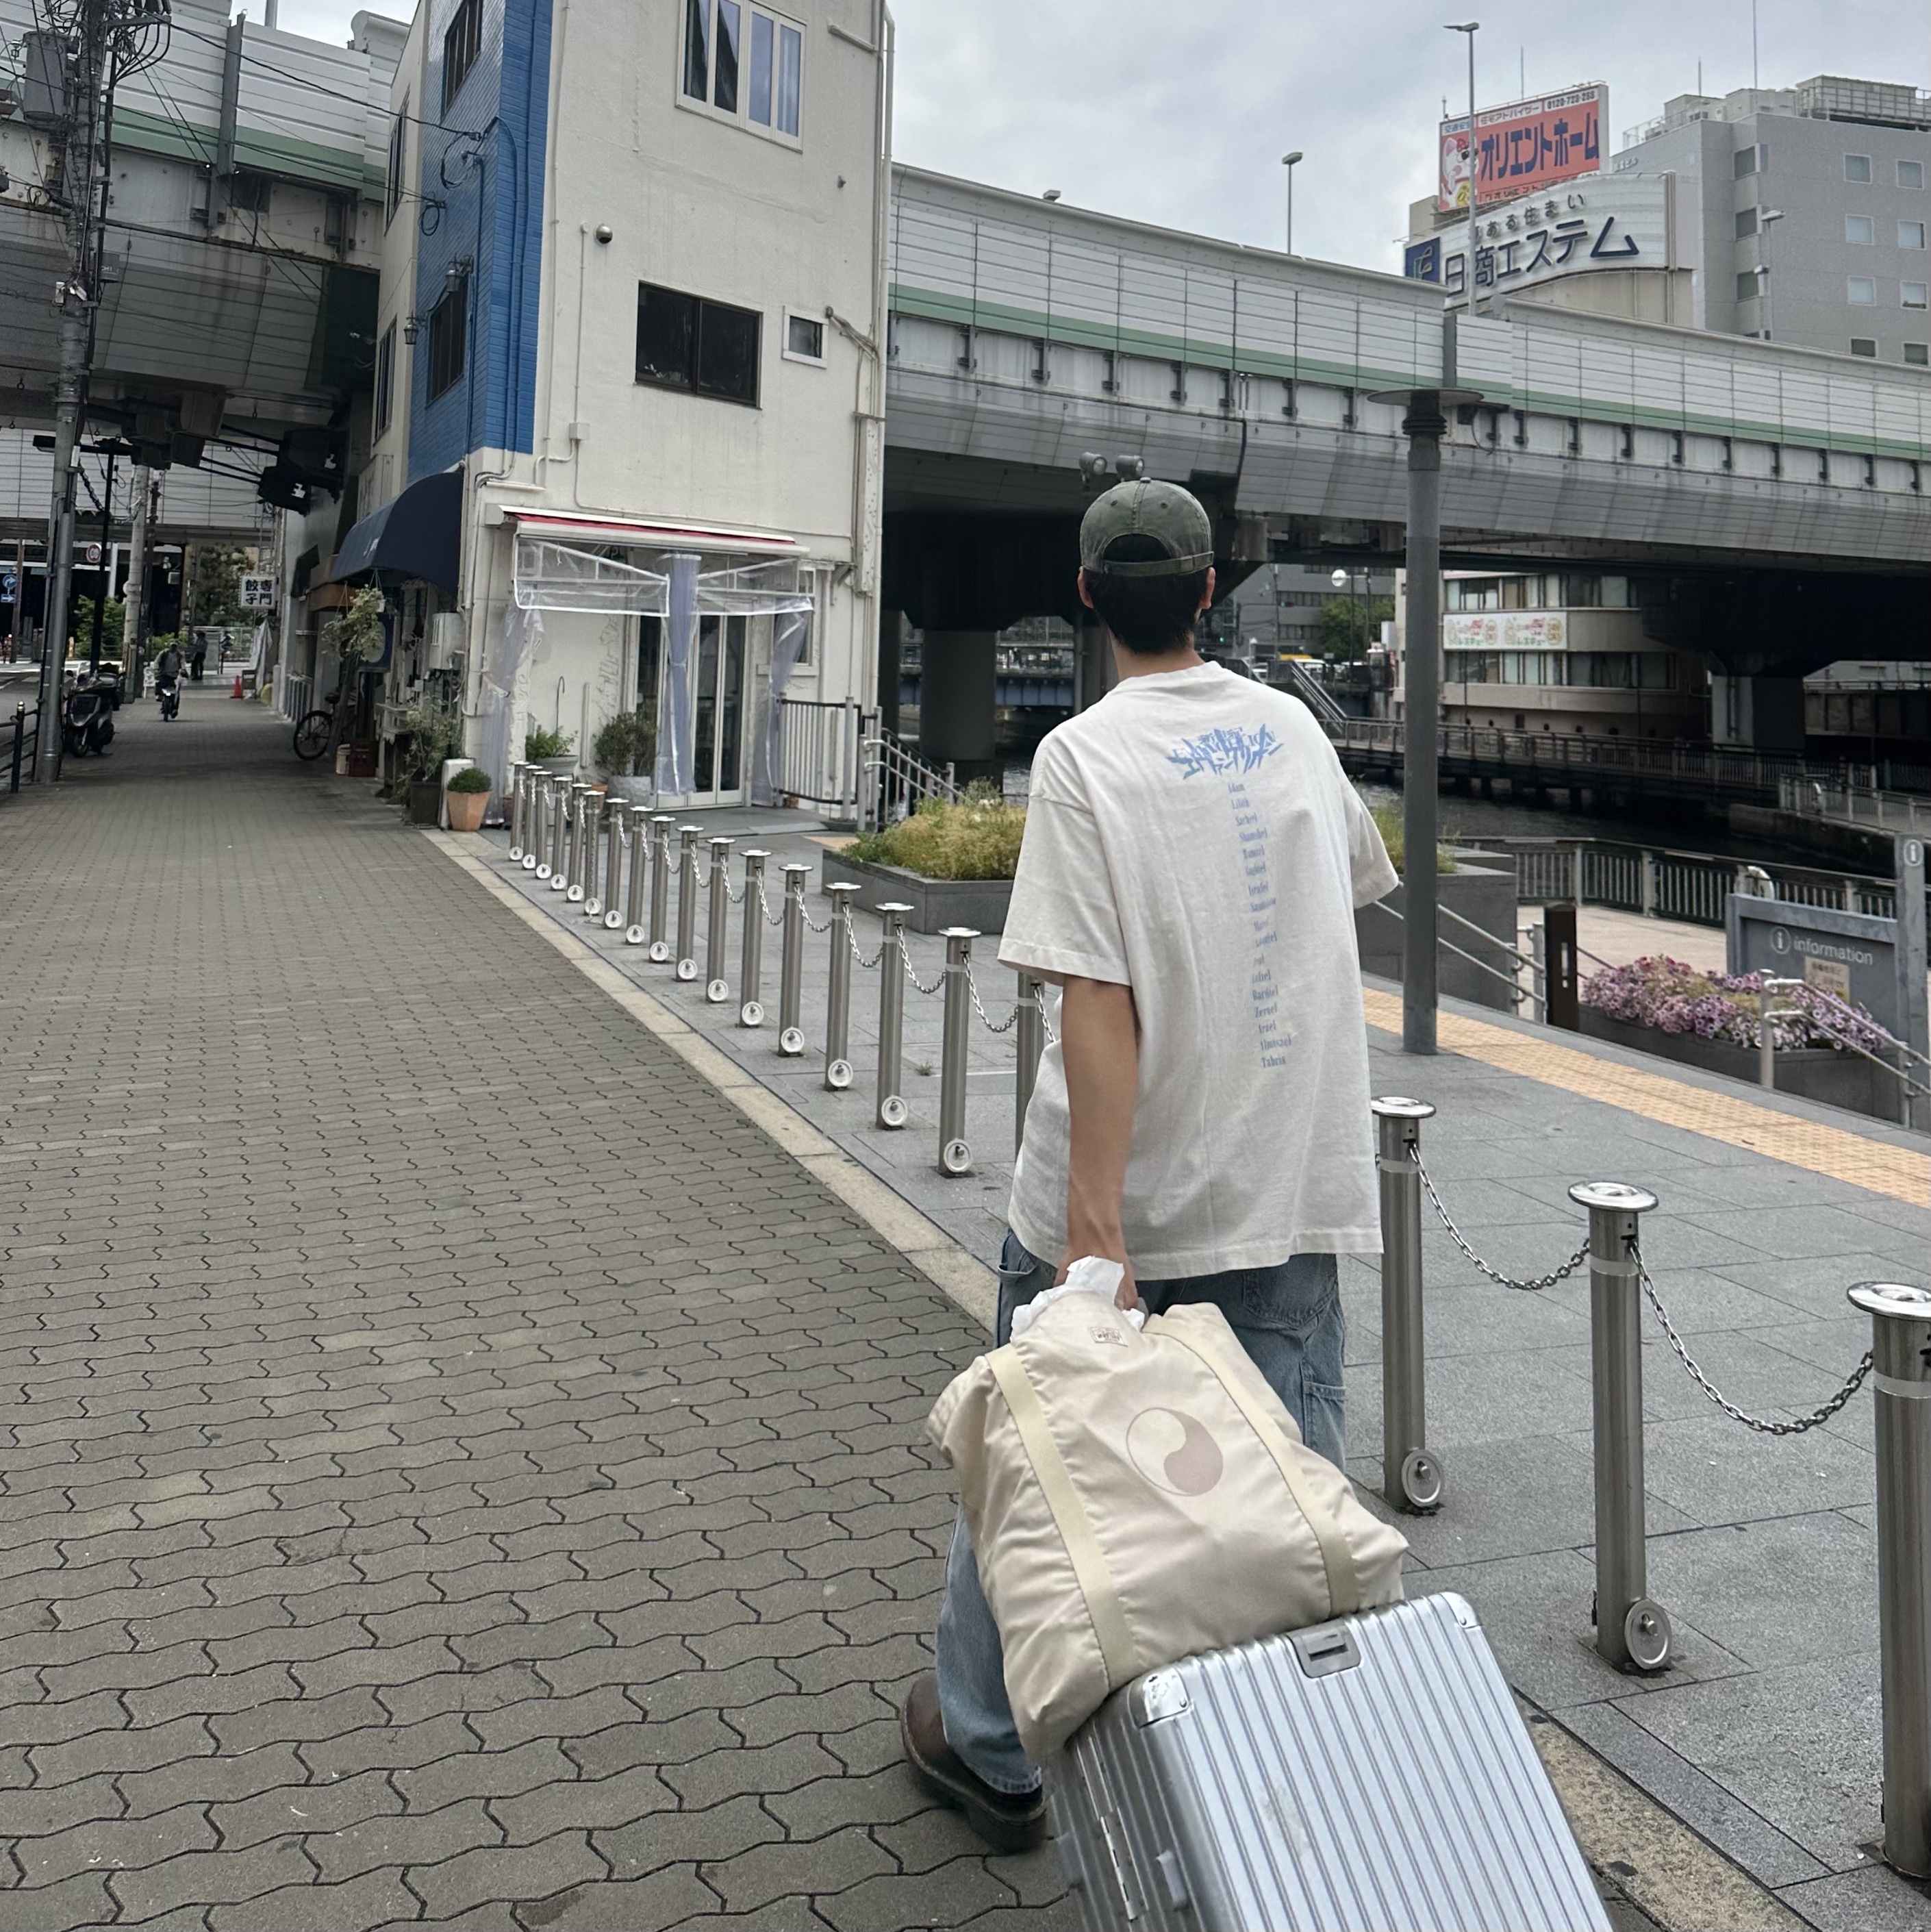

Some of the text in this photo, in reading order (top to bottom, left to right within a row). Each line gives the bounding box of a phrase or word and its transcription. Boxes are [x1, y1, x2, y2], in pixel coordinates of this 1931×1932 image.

[1480, 112, 1599, 181] オリエントホーム
[1446, 216, 1639, 297] 日商エステム
[1793, 936, 1873, 966] information
